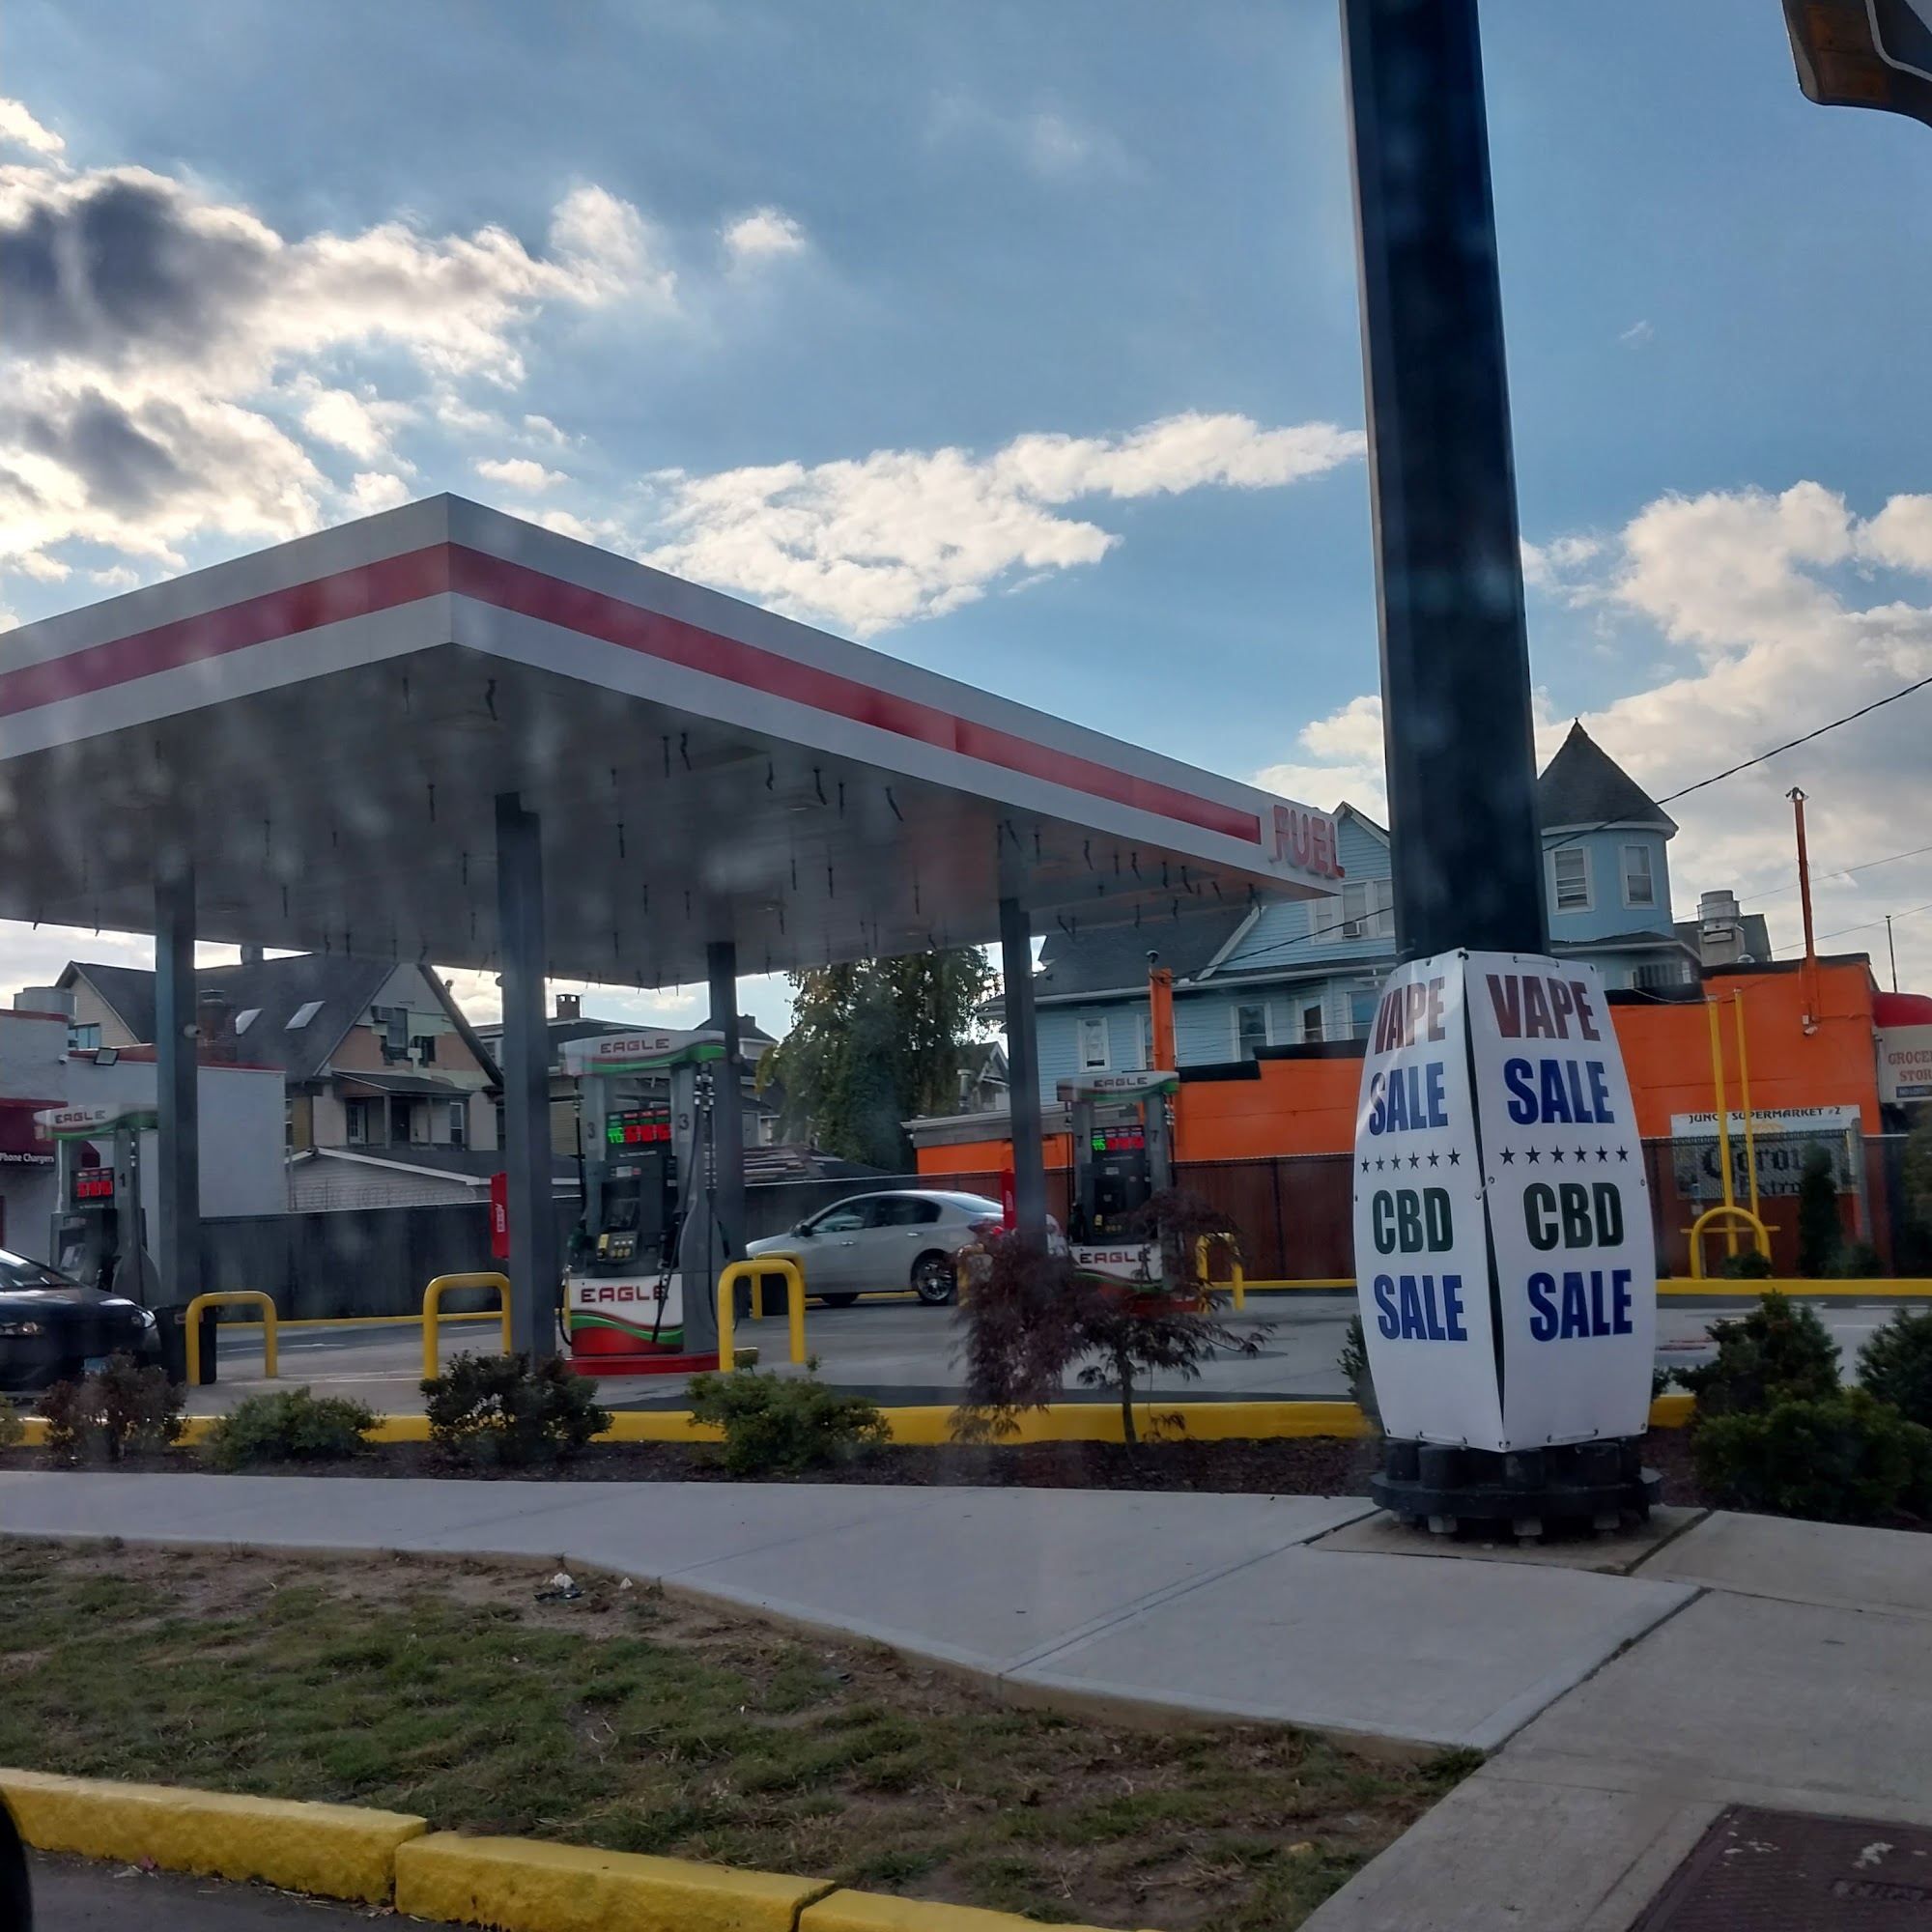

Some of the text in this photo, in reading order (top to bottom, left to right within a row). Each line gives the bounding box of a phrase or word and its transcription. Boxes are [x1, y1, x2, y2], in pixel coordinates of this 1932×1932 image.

[1272, 804, 1346, 879] FUEL
[1374, 976, 1446, 1055] VAPE
[1485, 974, 1601, 1041] VAPE
[601, 1038, 669, 1054] EAGLE
[1889, 1050, 1932, 1065] GROCE
[1094, 1077, 1148, 1088] EAGLE
[1369, 1062, 1448, 1136] SALE
[1503, 1058, 1615, 1125] SALE
[55, 1111, 105, 1123] EAGLE
[587, 1122, 596, 1139] 3
[678, 1113, 690, 1130] 3
[1150, 1129, 1158, 1142] 7
[1689, 1113, 1727, 1124] JUNC
[119, 1173, 126, 1187] 1
[1372, 1187, 1454, 1255] CBD
[1523, 1182, 1624, 1251] CBD
[1373, 1274, 1467, 1342] SALE
[1528, 1269, 1633, 1343] SALE
